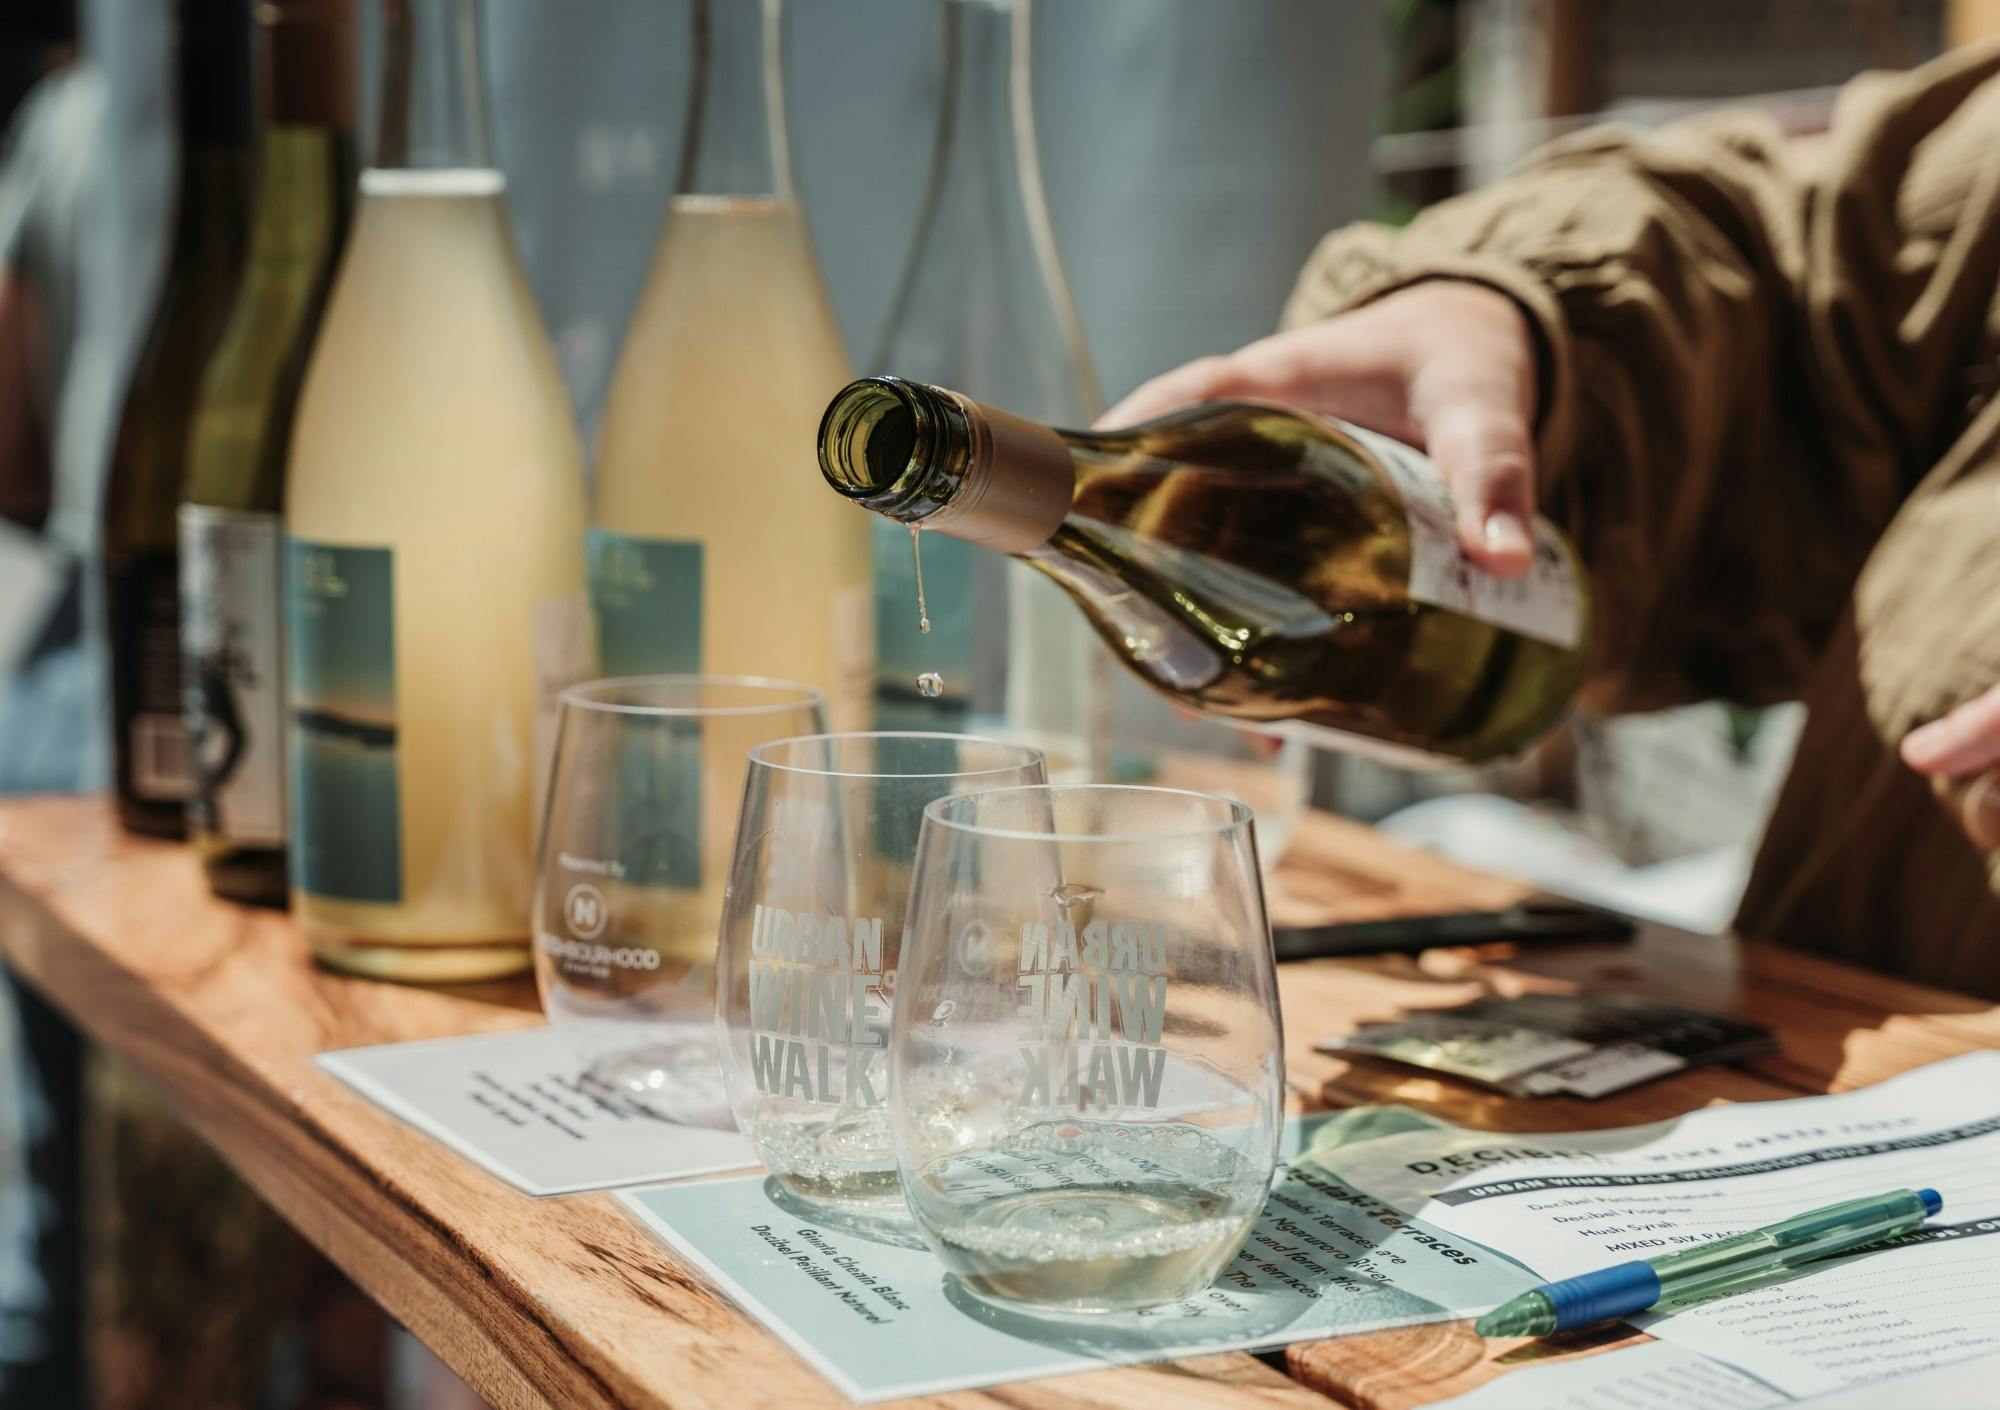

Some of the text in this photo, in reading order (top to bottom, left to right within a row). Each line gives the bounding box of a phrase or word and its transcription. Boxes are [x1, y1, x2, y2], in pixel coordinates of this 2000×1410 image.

[752, 904, 884, 974] URBAN
[750, 960, 884, 1048] WINE
[752, 1033, 882, 1107] WALK
[1406, 1149, 1598, 1175] DECIBEL
[1468, 1178, 1547, 1198] URBAN
[1548, 1175, 1611, 1187] WINE
[1527, 1197, 1596, 1211] Decibel
[1552, 1208, 1621, 1223] Decibel
[1578, 1220, 1680, 1237] Hush Syrah
[750, 1225, 804, 1255] Decibel
[1269, 1217, 1395, 1284] Ngaruroro River
[1312, 1212, 1378, 1249] Terraces
[1376, 1249, 1407, 1265] are
[1366, 1207, 1477, 1266] Terraces
[1605, 1239, 1666, 1252] MIXED
[1668, 1233, 1701, 1244] SIX
[832, 1256, 878, 1285] Chenin
[871, 1286, 911, 1310] Blanc
[1224, 1270, 1257, 1289] The
[1256, 1235, 1299, 1253] and
[1330, 1274, 1361, 1294] the
[1257, 1263, 1323, 1300] terraces
